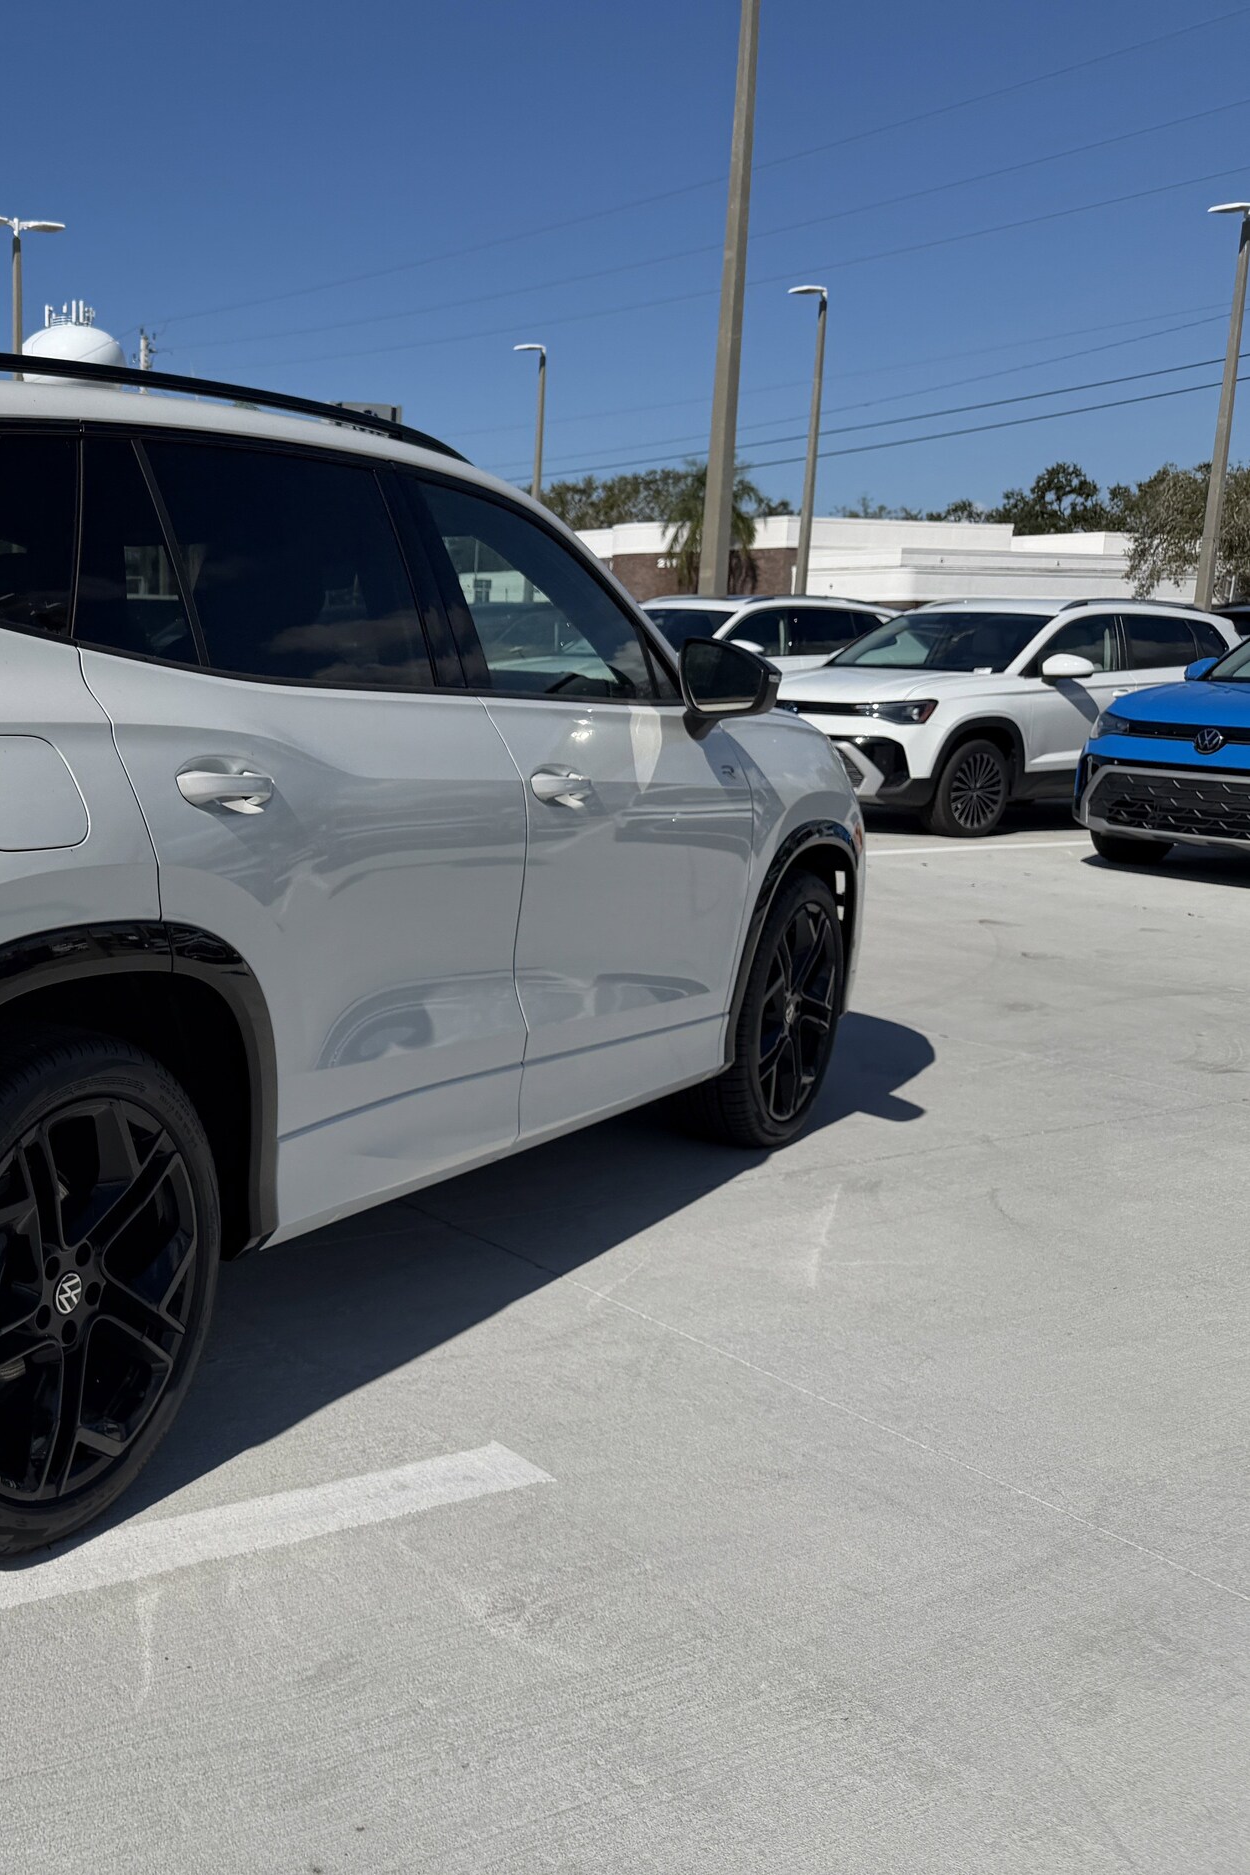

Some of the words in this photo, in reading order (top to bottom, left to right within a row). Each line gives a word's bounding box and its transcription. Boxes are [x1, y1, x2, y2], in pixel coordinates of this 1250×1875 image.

[1196, 728, 1222, 754] VW
[721, 765, 736, 779] R
[56, 1273, 82, 1314] VW
